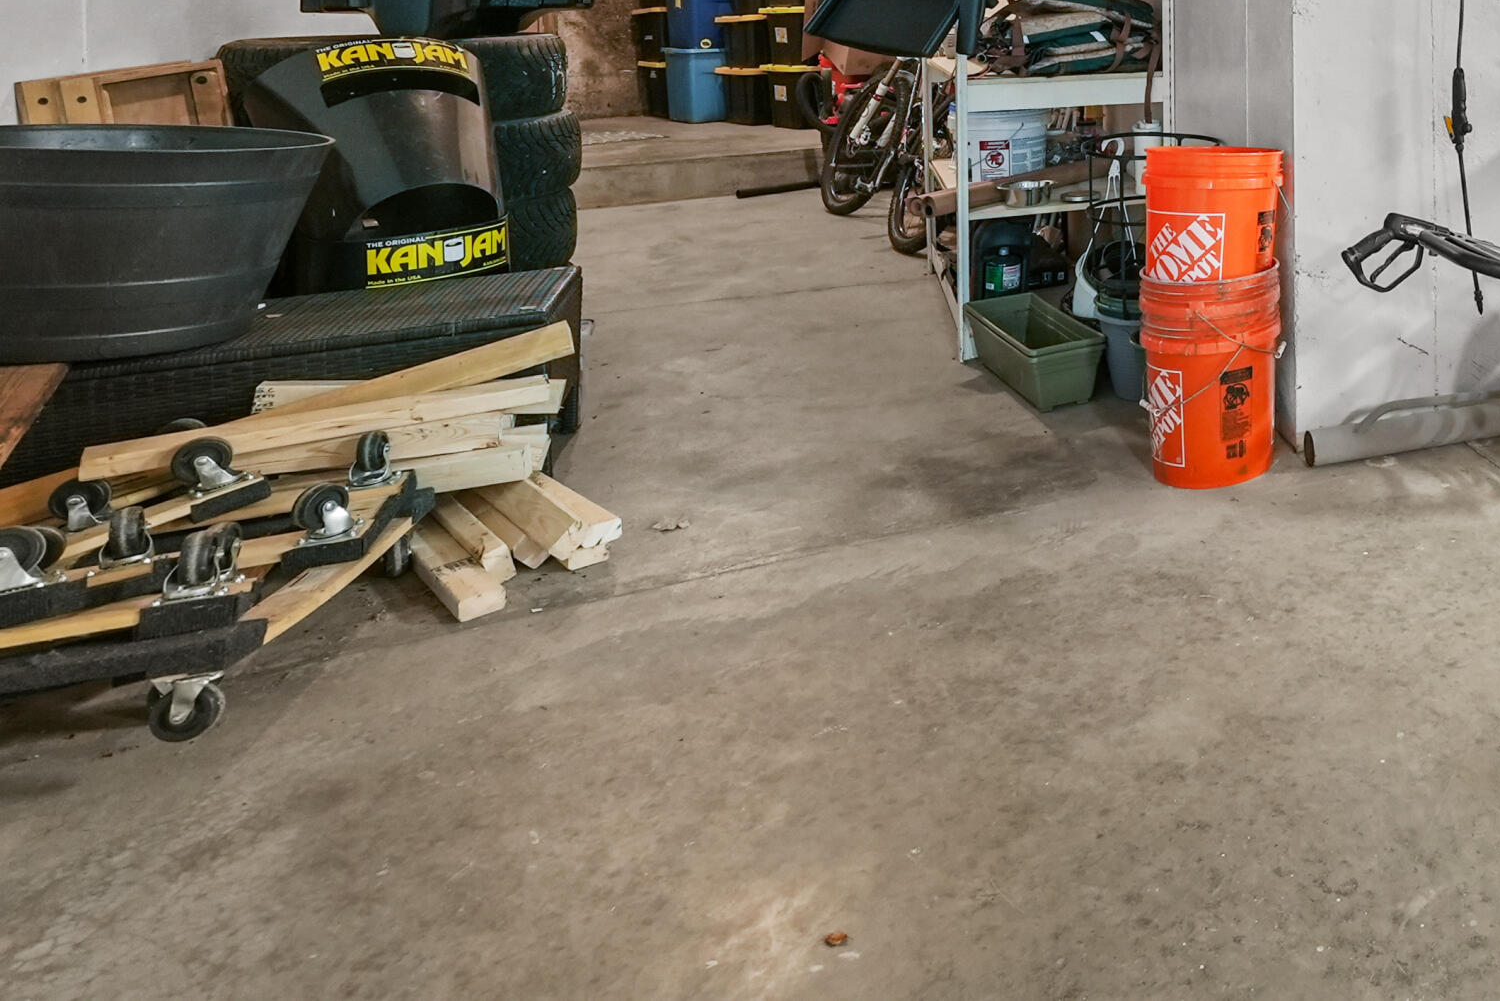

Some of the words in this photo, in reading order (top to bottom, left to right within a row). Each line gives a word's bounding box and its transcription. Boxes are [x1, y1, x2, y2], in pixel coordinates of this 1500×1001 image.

[315, 46, 332, 54] THE
[333, 39, 373, 50] ORIGINAL
[316, 42, 396, 72] KAN
[413, 42, 469, 70] JAM
[366, 241, 384, 249] THE
[385, 236, 427, 247] ORIGINAL
[366, 240, 444, 276] KAN
[460, 226, 506, 268] JAM
[1149, 214, 1223, 283] OME
[1150, 222, 1177, 260] THE
